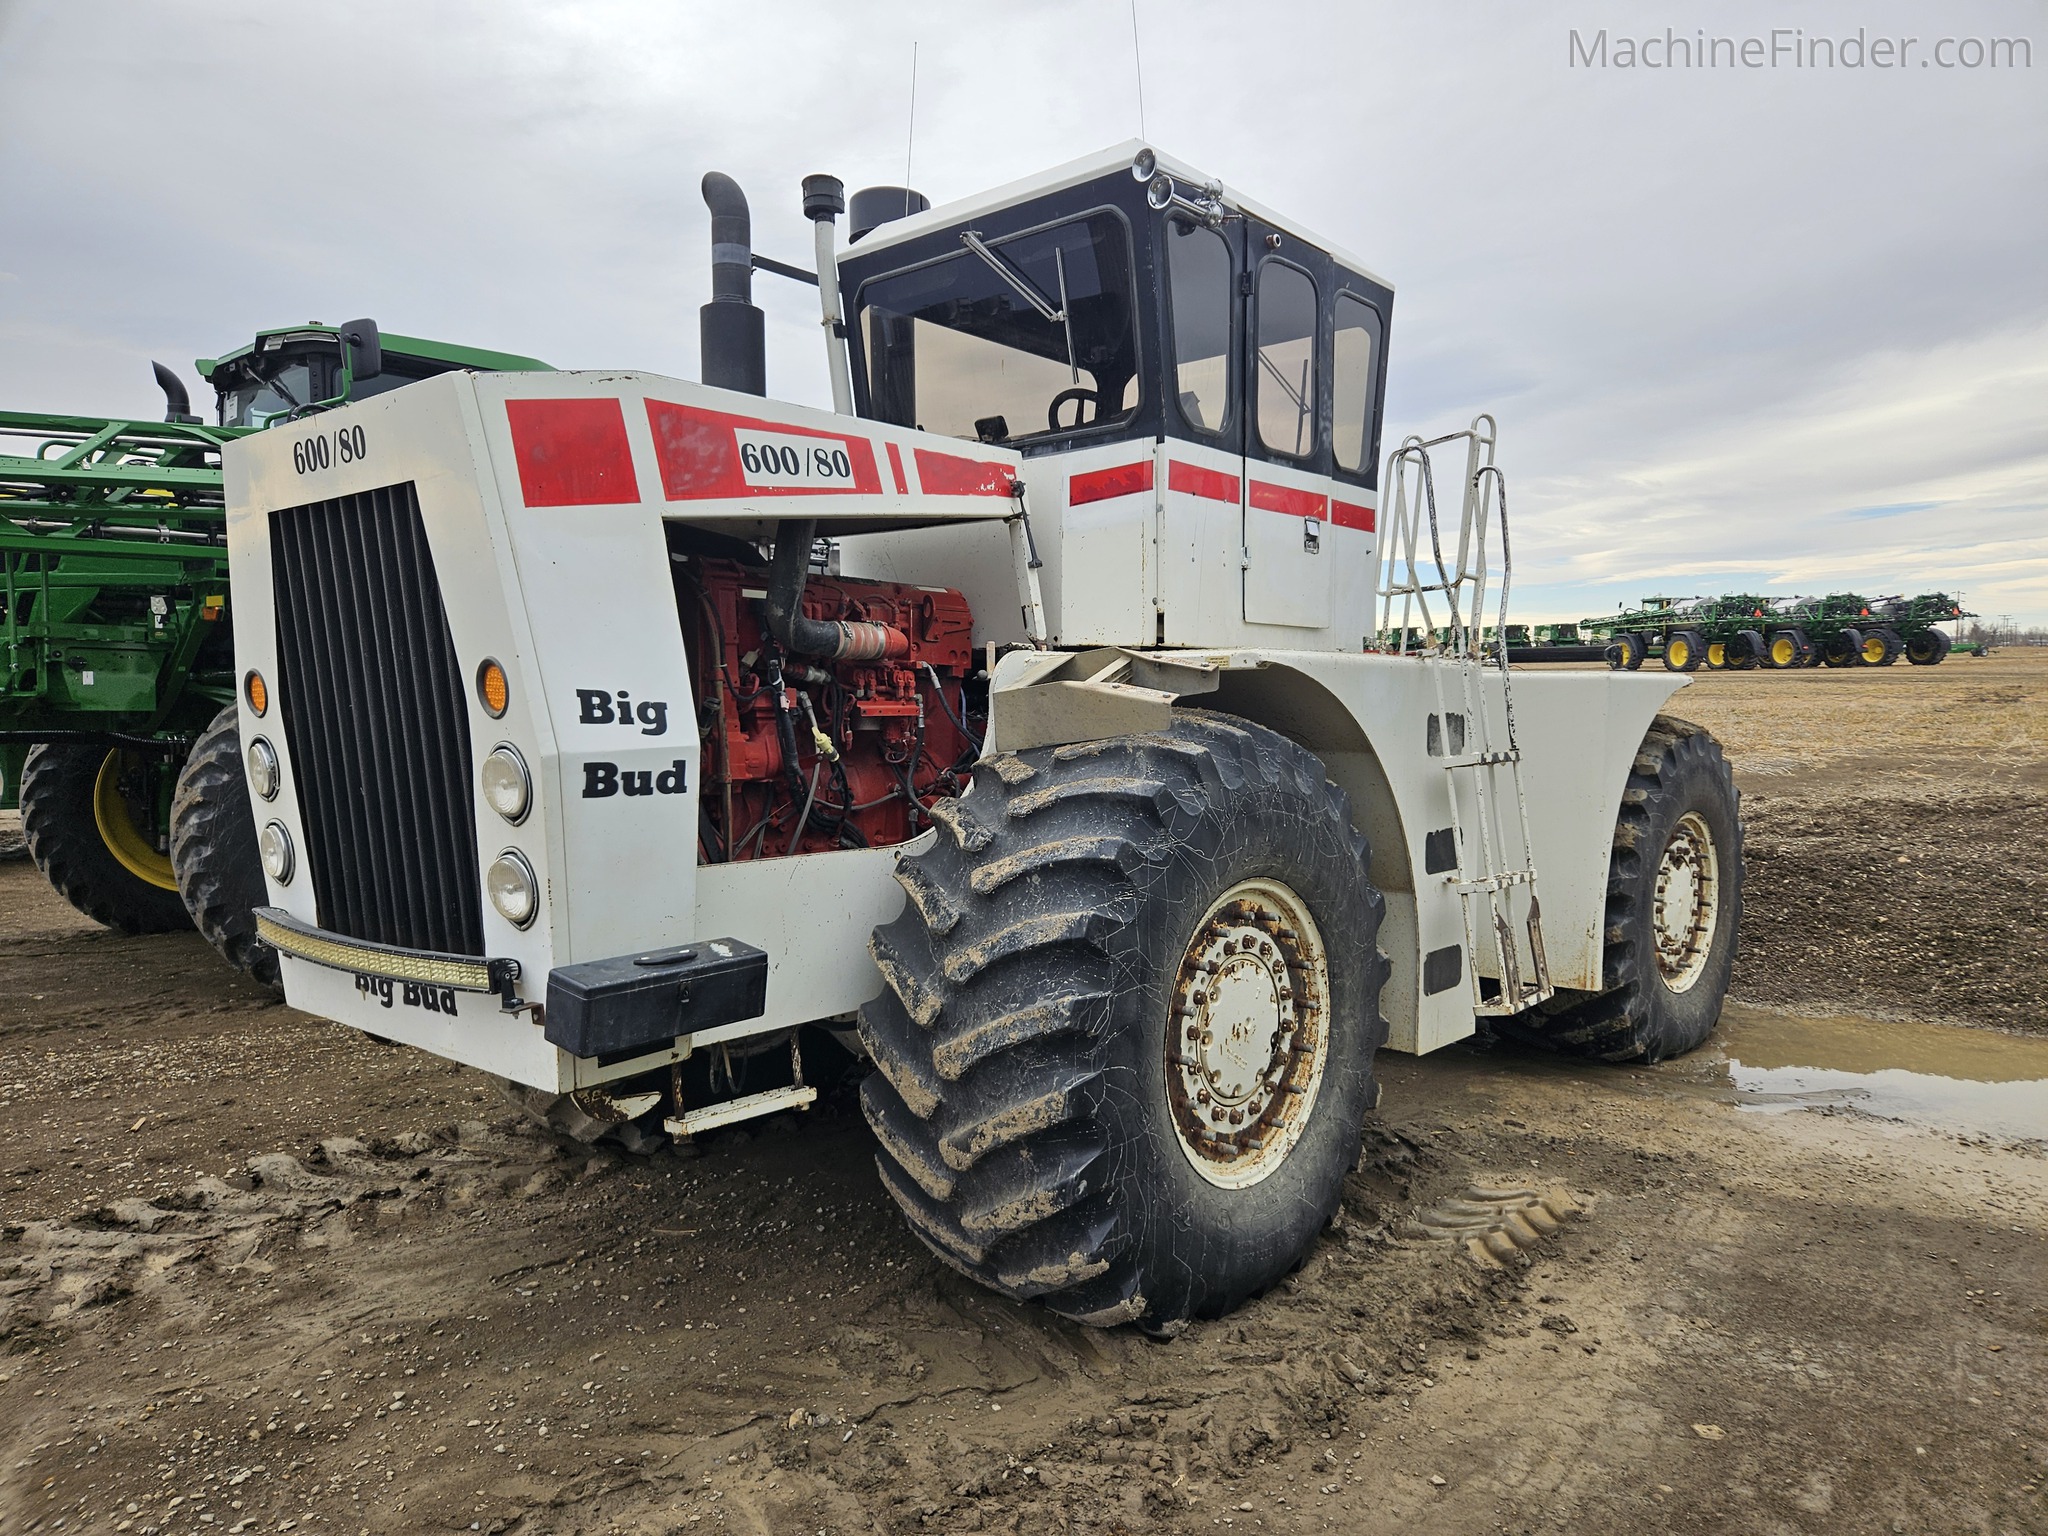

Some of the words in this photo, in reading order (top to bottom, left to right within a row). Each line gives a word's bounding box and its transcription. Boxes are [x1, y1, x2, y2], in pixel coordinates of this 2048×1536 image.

[294, 424, 366, 475] 600/80
[741, 443, 851, 478] 600/80
[576, 689, 668, 736] Big
[582, 760, 687, 798] Bud
[403, 982, 458, 1017] Bud
